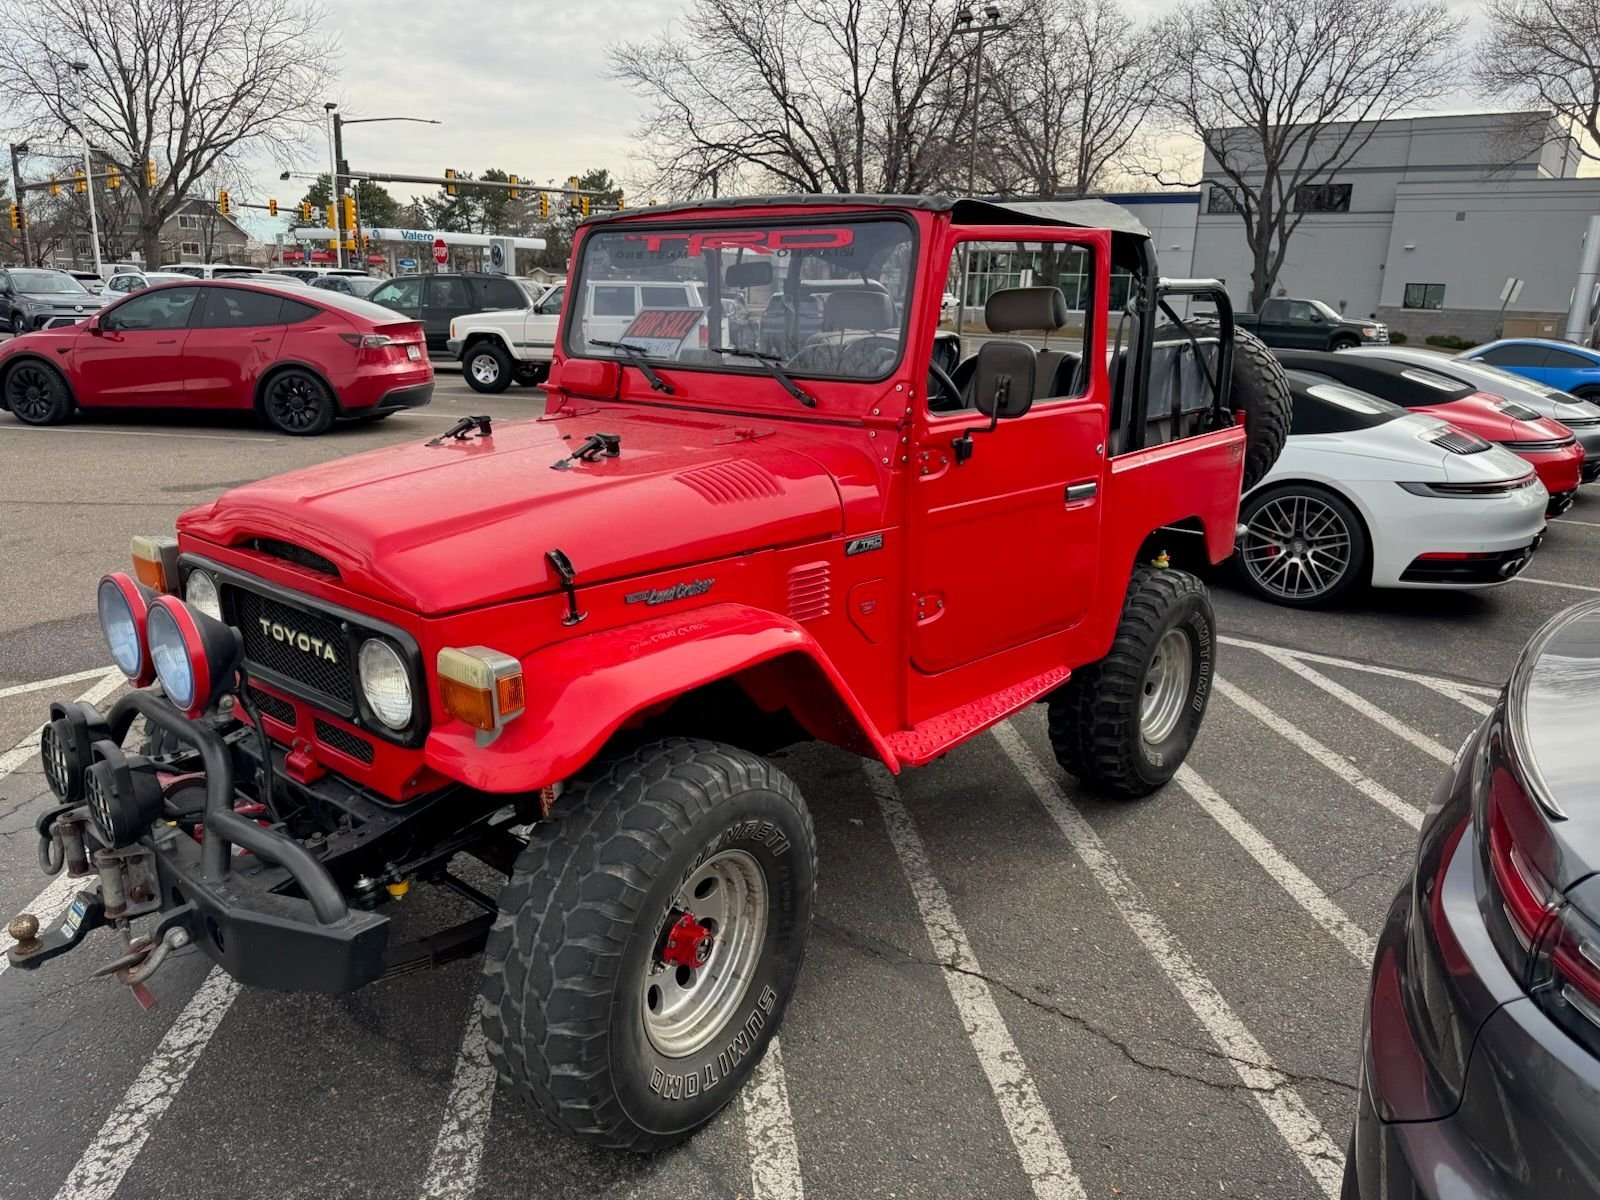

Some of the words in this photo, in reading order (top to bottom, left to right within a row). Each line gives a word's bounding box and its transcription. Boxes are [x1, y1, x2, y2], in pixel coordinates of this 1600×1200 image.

[401, 230, 434, 241] Valero
[624, 228, 854, 256] TRD
[433, 246, 448, 257] STOP
[626, 311, 664, 336] FOR
[654, 311, 700, 338] SALE
[259, 617, 336, 663] TOYOTA
[650, 984, 777, 1100] SUMITOMO
